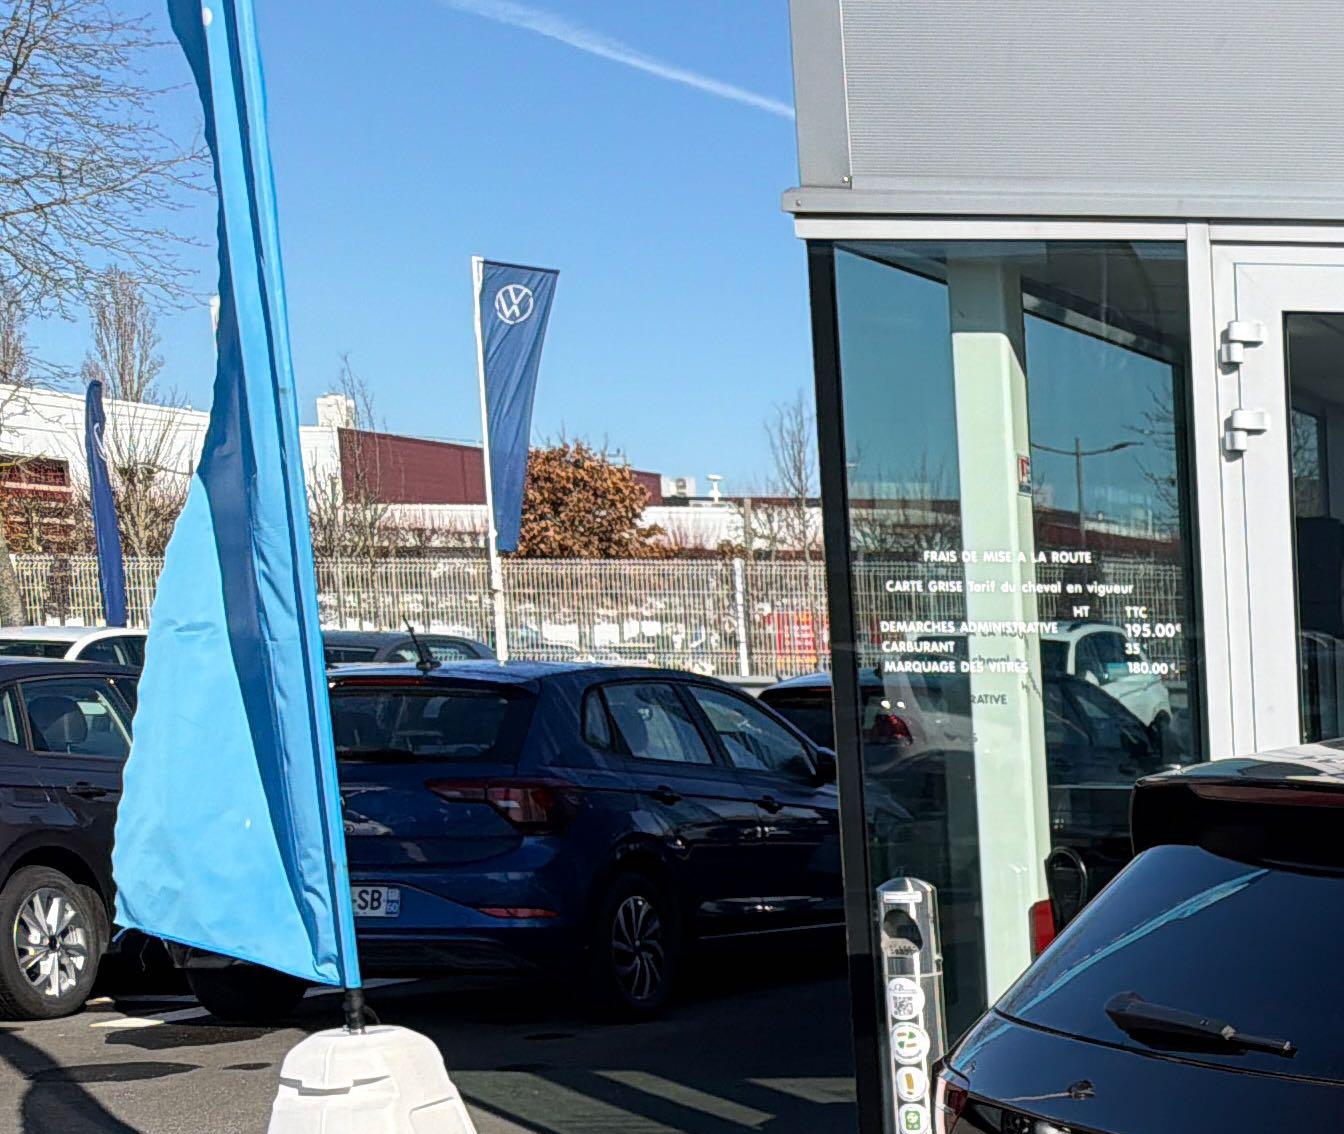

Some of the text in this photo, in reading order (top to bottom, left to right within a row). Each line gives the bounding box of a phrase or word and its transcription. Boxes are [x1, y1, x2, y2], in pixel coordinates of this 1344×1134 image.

[923, 551, 957, 562] FRAIS
[962, 551, 977, 562] DE
[984, 551, 1011, 562] MISE
[1031, 551, 1047, 563] LA
[1052, 551, 1092, 563] ROUTE
[886, 580, 1134, 597] CARTE GRISE Tarif du cheval en vigueur
[1073, 606, 1148, 618] HT TTC
[879, 621, 956, 634] DEMARCHES
[960, 622, 1059, 634] ADMINISTRATIVE
[882, 641, 956, 653] CARBURANT
[884, 661, 956, 673] MARQUAGE
[961, 661, 984, 673] DES
[989, 661, 1029, 673] VITRES
